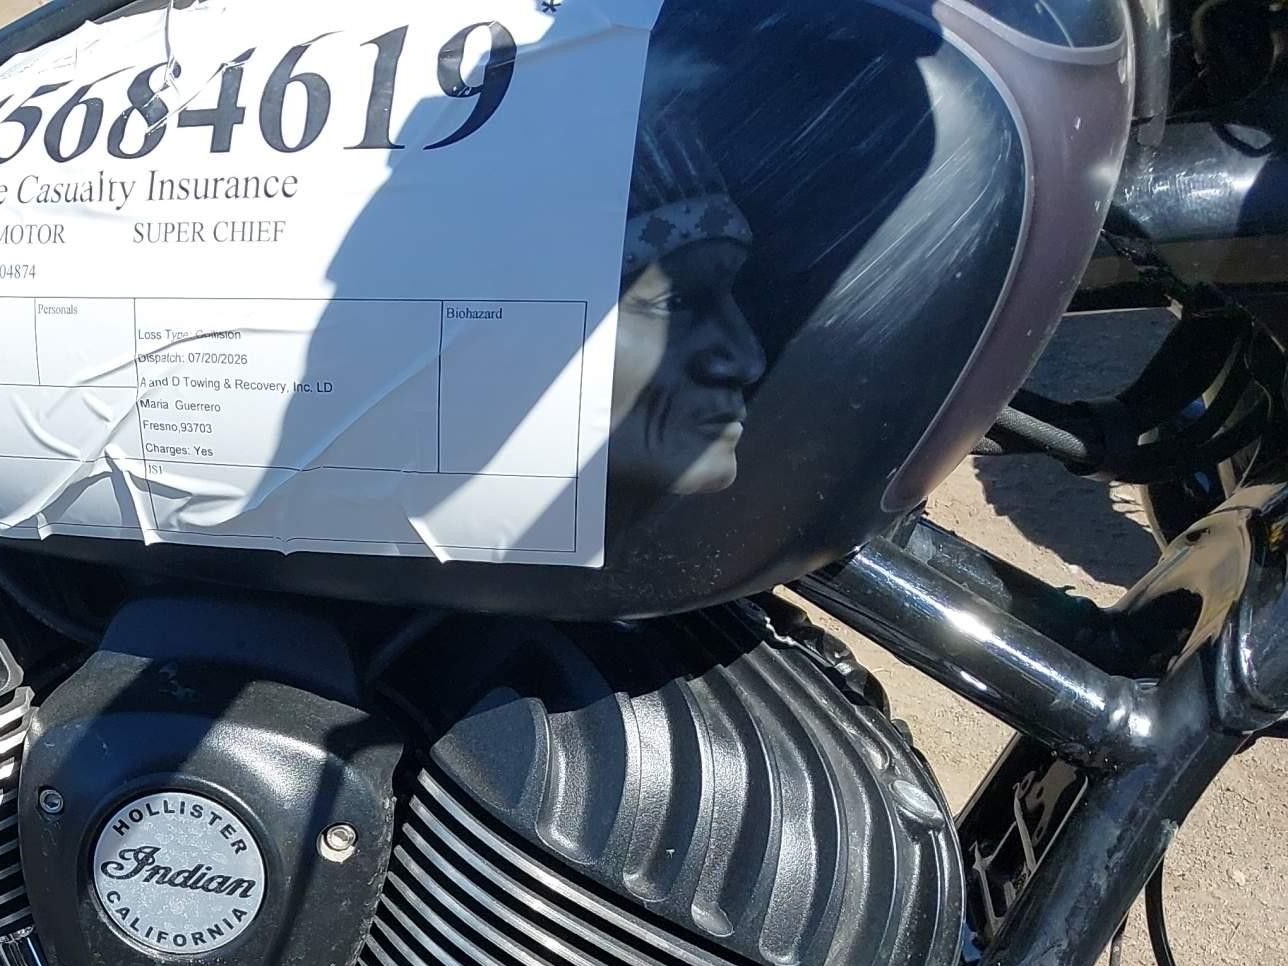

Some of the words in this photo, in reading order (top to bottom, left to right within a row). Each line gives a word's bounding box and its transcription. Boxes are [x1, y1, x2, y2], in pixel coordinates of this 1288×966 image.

[17, 170, 136, 210] Casualty
[147, 170, 298, 201] Insurance
[133, 221, 205, 244] SUPER
[213, 220, 287, 243] CHIEF
[37, 304, 78, 316] Personals
[446, 308, 503, 320] Biohazard
[138, 329, 162, 340] Loss
[138, 353, 185, 366] Dispatch:
[188, 353, 248, 366] 07/20/2026
[140, 377, 147, 388] A
[148, 377, 168, 388] and
[172, 376, 180, 387] D
[184, 377, 219, 392] Towing
[224, 379, 232, 389] &
[235, 379, 289, 394] Recovery,
[293, 382, 313, 393] Inc.
[317, 382, 333, 393] LD
[140, 399, 169, 410] Maria
[175, 400, 221, 412] Guerrero
[143, 420, 213, 434] Fresno,93703
[145, 442, 190, 456] Charges:
[194, 446, 214, 457] Yes
[112, 799, 248, 854] HOLLISTER
[100, 845, 256, 899] Indian
[106, 890, 248, 947] CALIFORNIA
